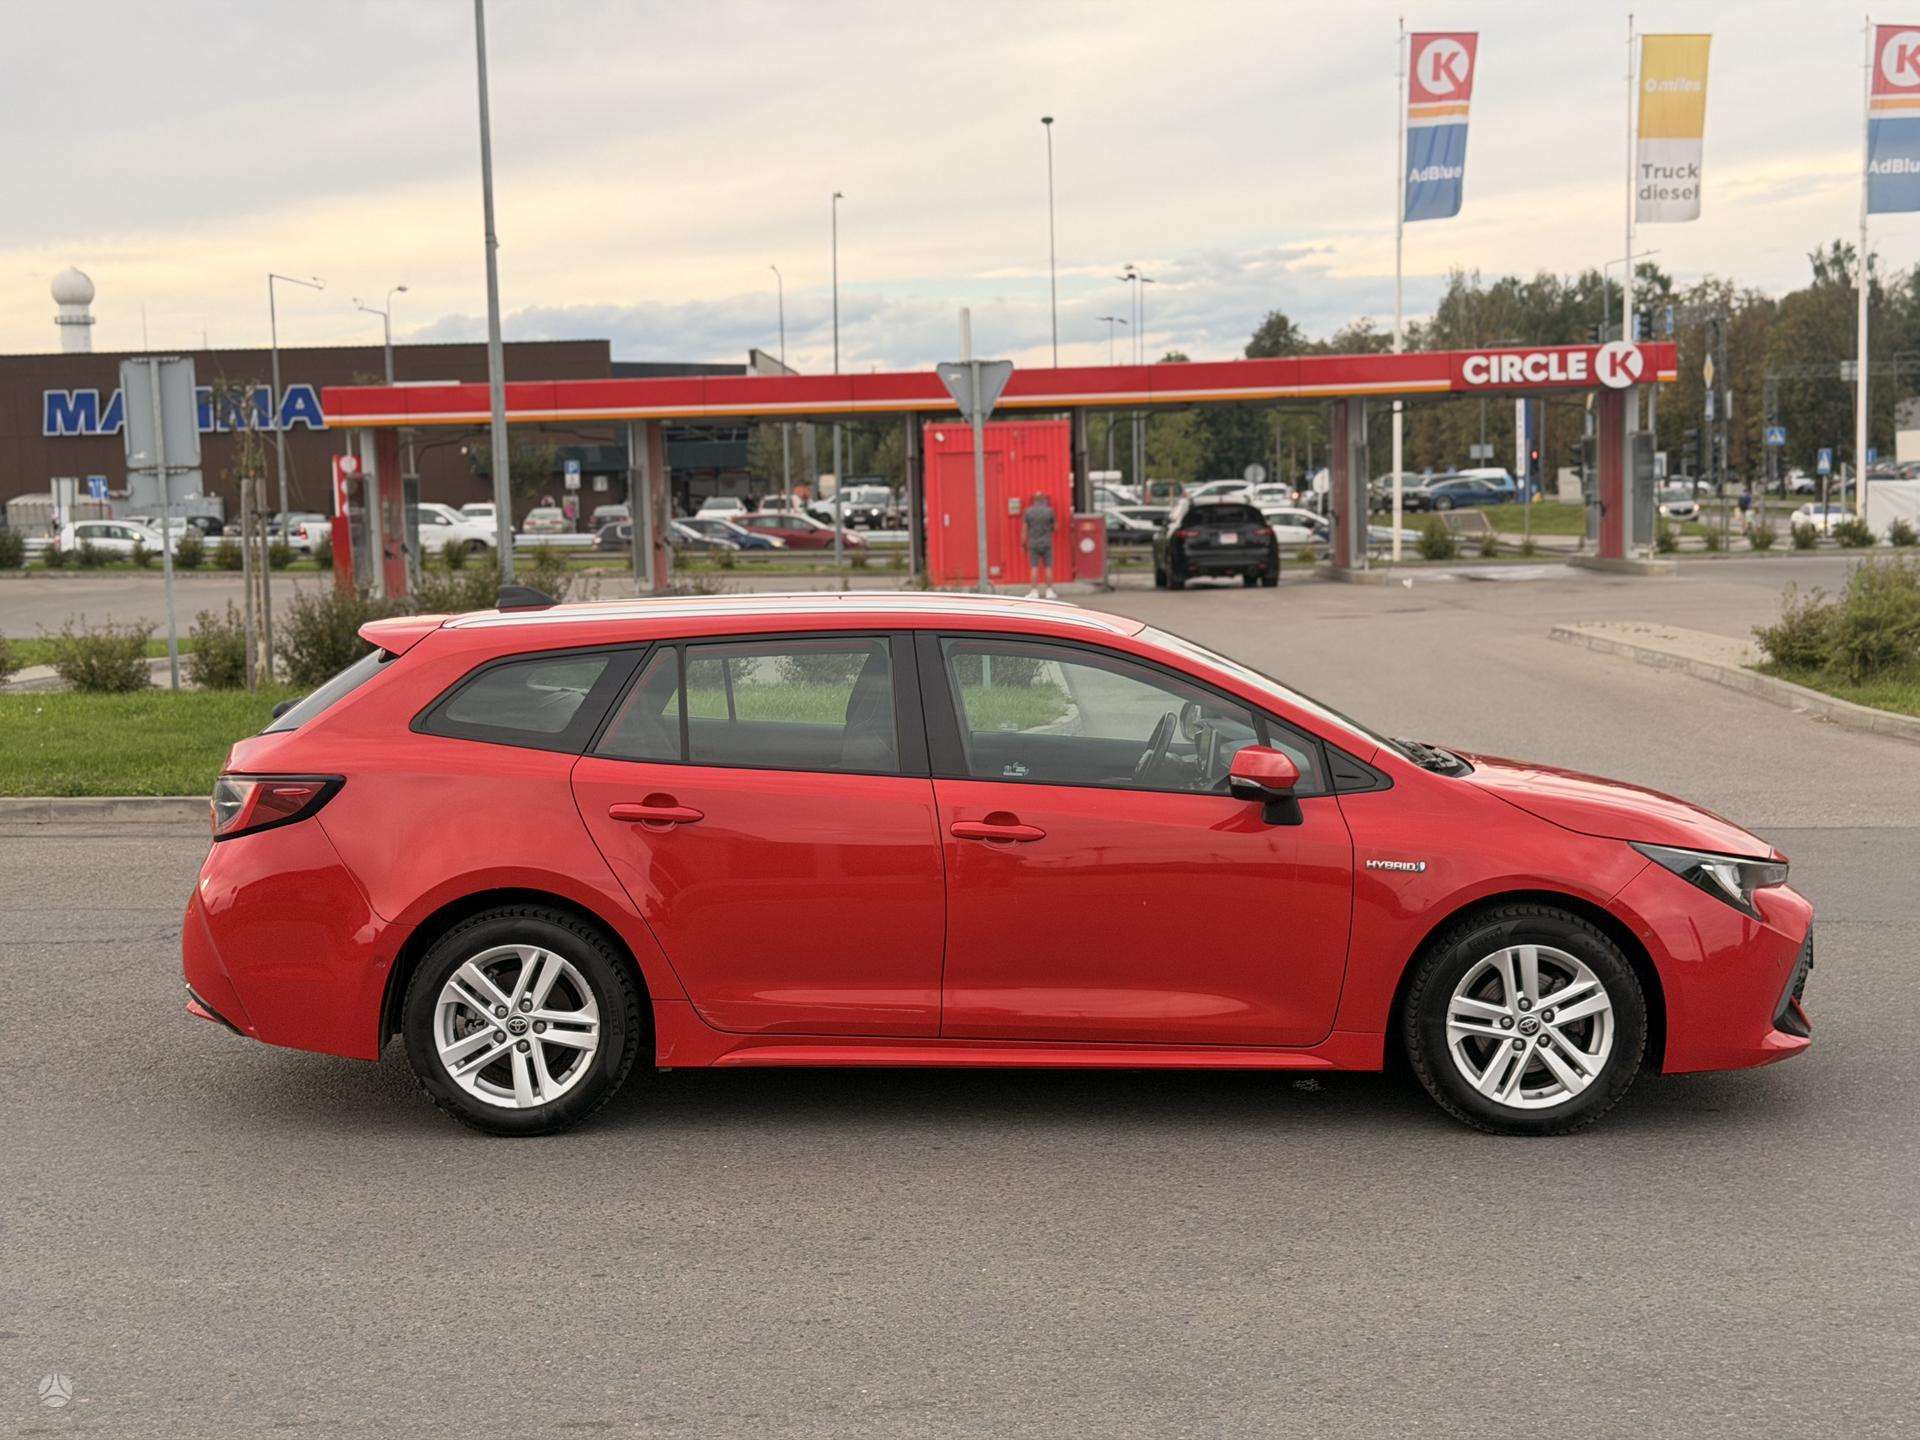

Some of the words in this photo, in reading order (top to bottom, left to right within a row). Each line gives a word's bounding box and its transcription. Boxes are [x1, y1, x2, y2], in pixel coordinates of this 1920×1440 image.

[1409, 165, 1462, 183] AdBlue
[1641, 163, 1698, 179] Truck
[1639, 184, 1700, 201] diesel
[1462, 352, 1588, 384] CIRCLE
[43, 384, 330, 436] MIMA
[1366, 860, 1416, 871] HYBRID
